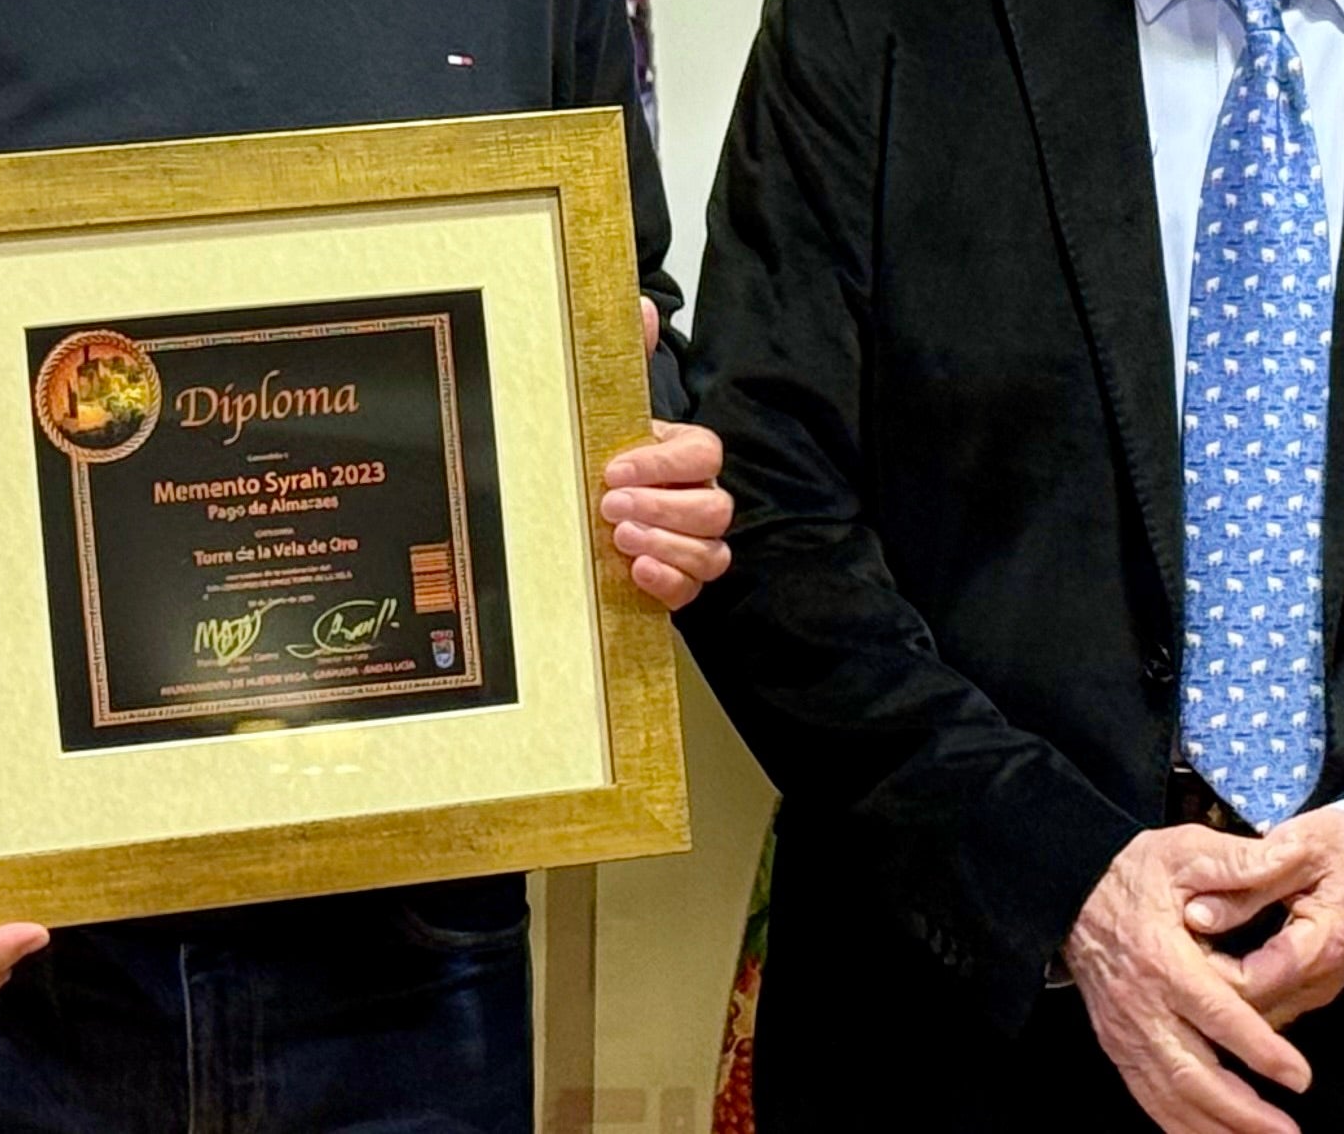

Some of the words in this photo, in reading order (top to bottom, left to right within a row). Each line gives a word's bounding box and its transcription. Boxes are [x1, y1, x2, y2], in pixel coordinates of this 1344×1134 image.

[176, 370, 360, 446] Diploma
[154, 476, 260, 504] Memento
[265, 466, 327, 496] Syrah
[331, 462, 386, 487] 2023
[208, 504, 246, 522] Pago
[248, 500, 267, 515] de
[193, 550, 233, 566] Torre
[236, 546, 255, 562] de
[258, 544, 272, 559] la
[273, 540, 305, 557] Vela
[308, 539, 327, 554] de
[330, 536, 358, 552] Oro
